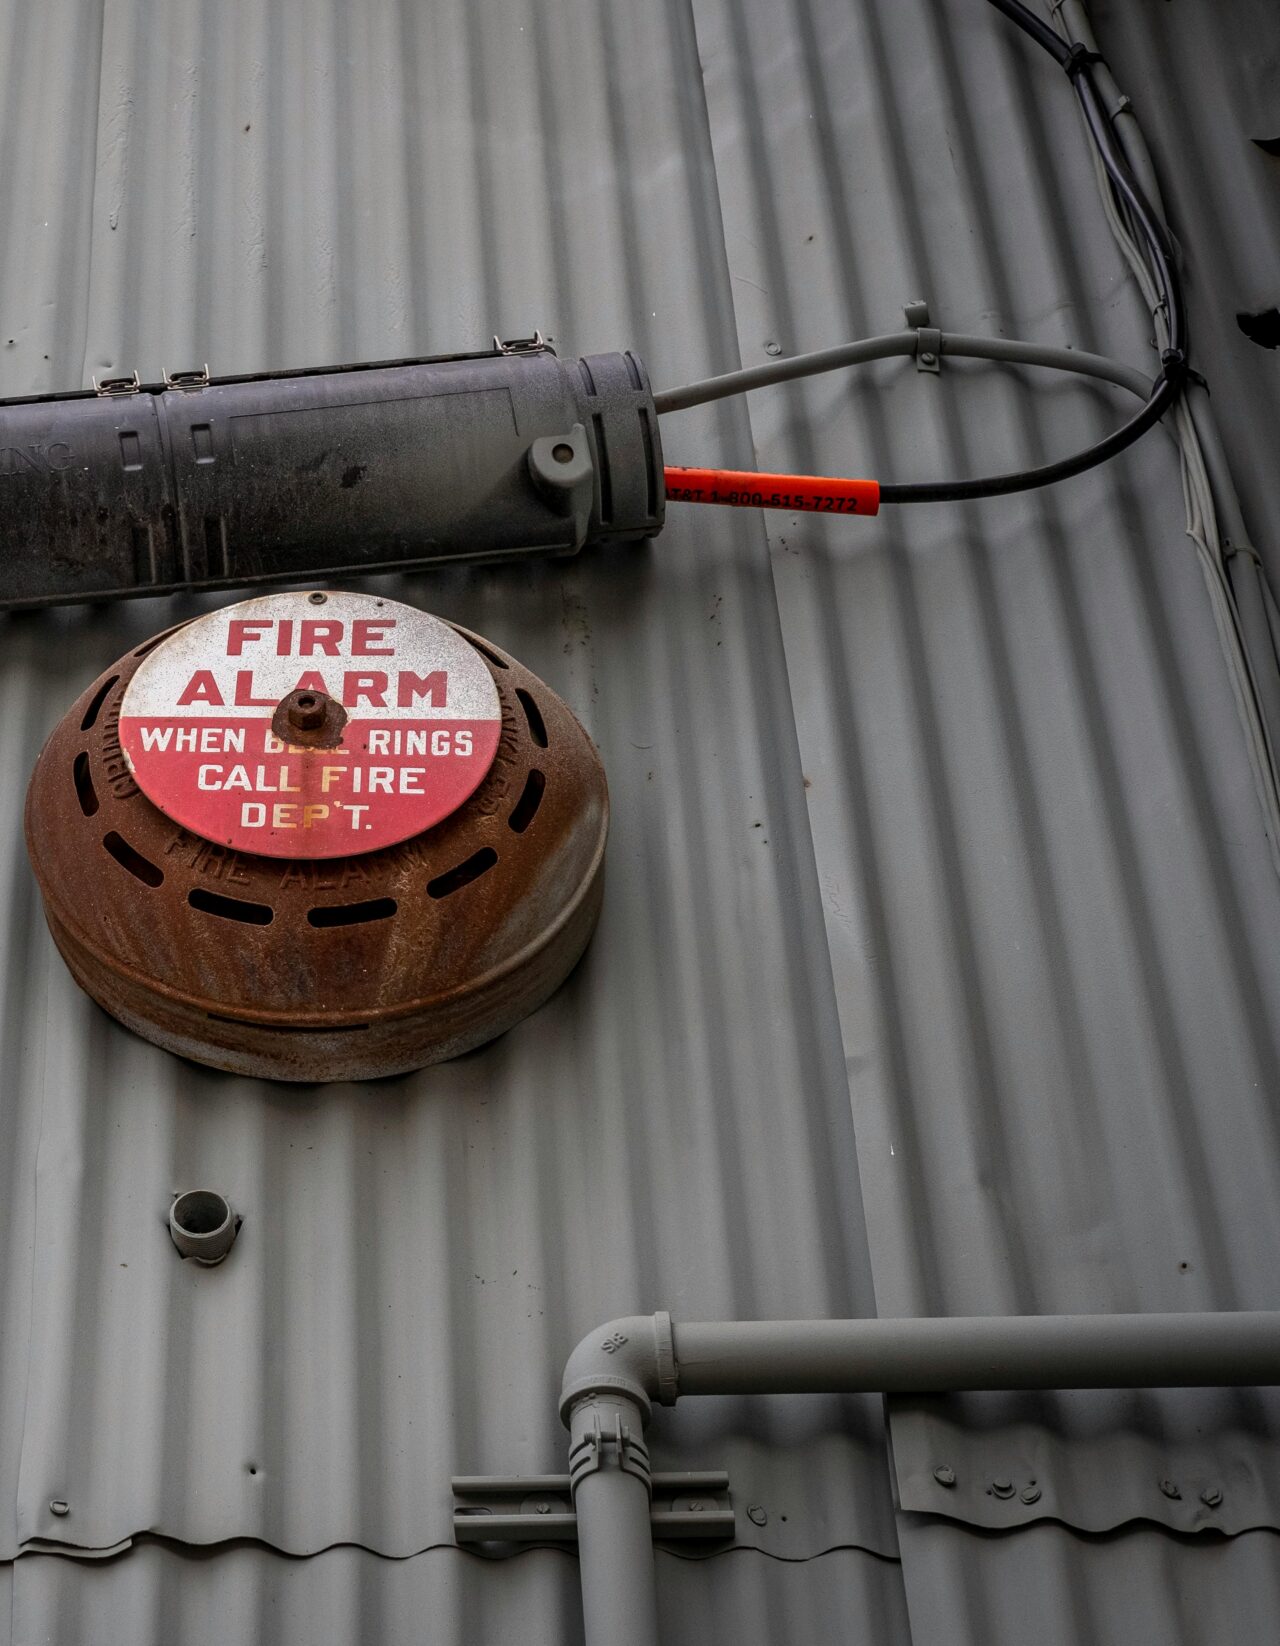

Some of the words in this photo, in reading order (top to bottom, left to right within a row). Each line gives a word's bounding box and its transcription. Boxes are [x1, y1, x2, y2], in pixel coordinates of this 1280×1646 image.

[226, 619, 397, 656] FIRE
[140, 727, 246, 753] WHEN
[368, 729, 473, 756] RINGS
[197, 764, 301, 791] CALL
[321, 766, 426, 794] FIRE
